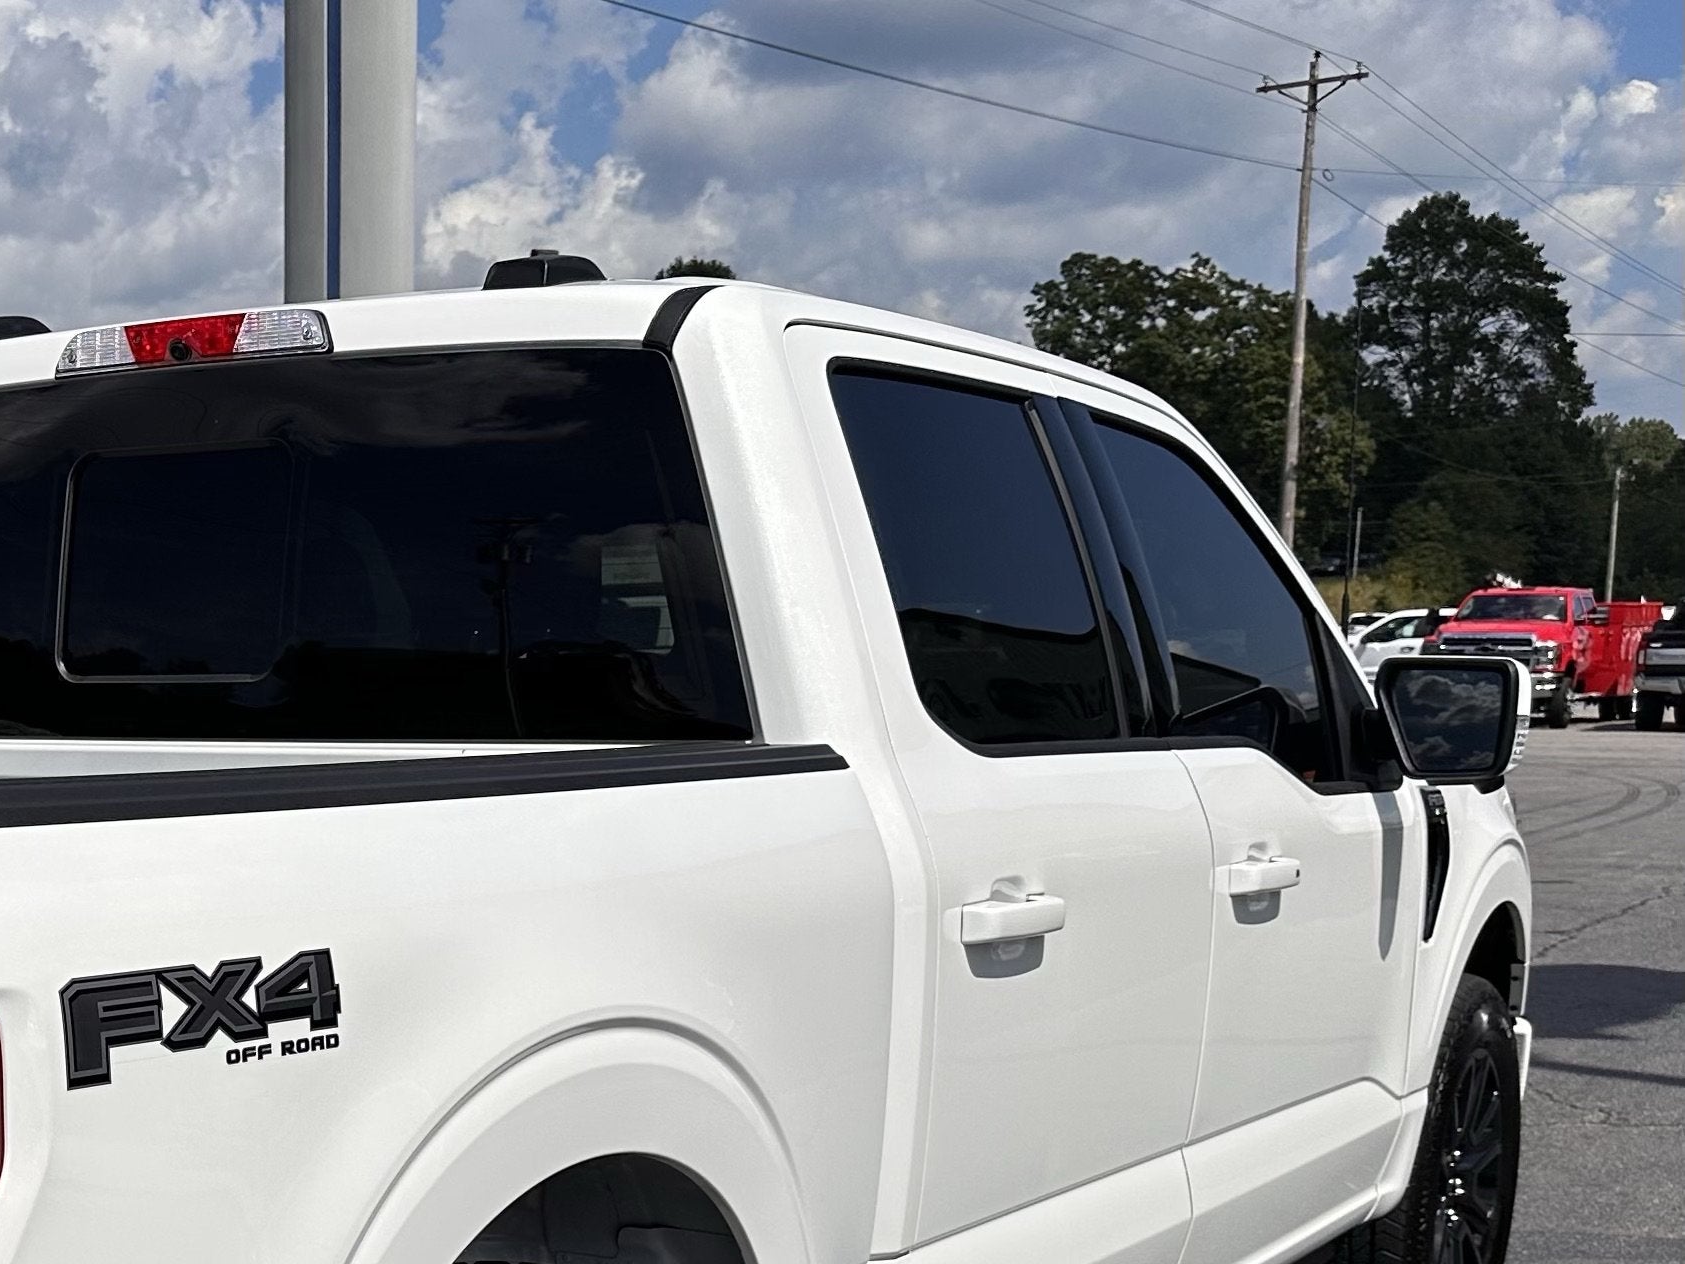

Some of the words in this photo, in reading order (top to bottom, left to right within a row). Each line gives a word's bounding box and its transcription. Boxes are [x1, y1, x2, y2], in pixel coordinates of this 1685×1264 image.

[58, 947, 342, 1092] FX4
[225, 1043, 272, 1065] OFF
[280, 1033, 340, 1057] ROAD
